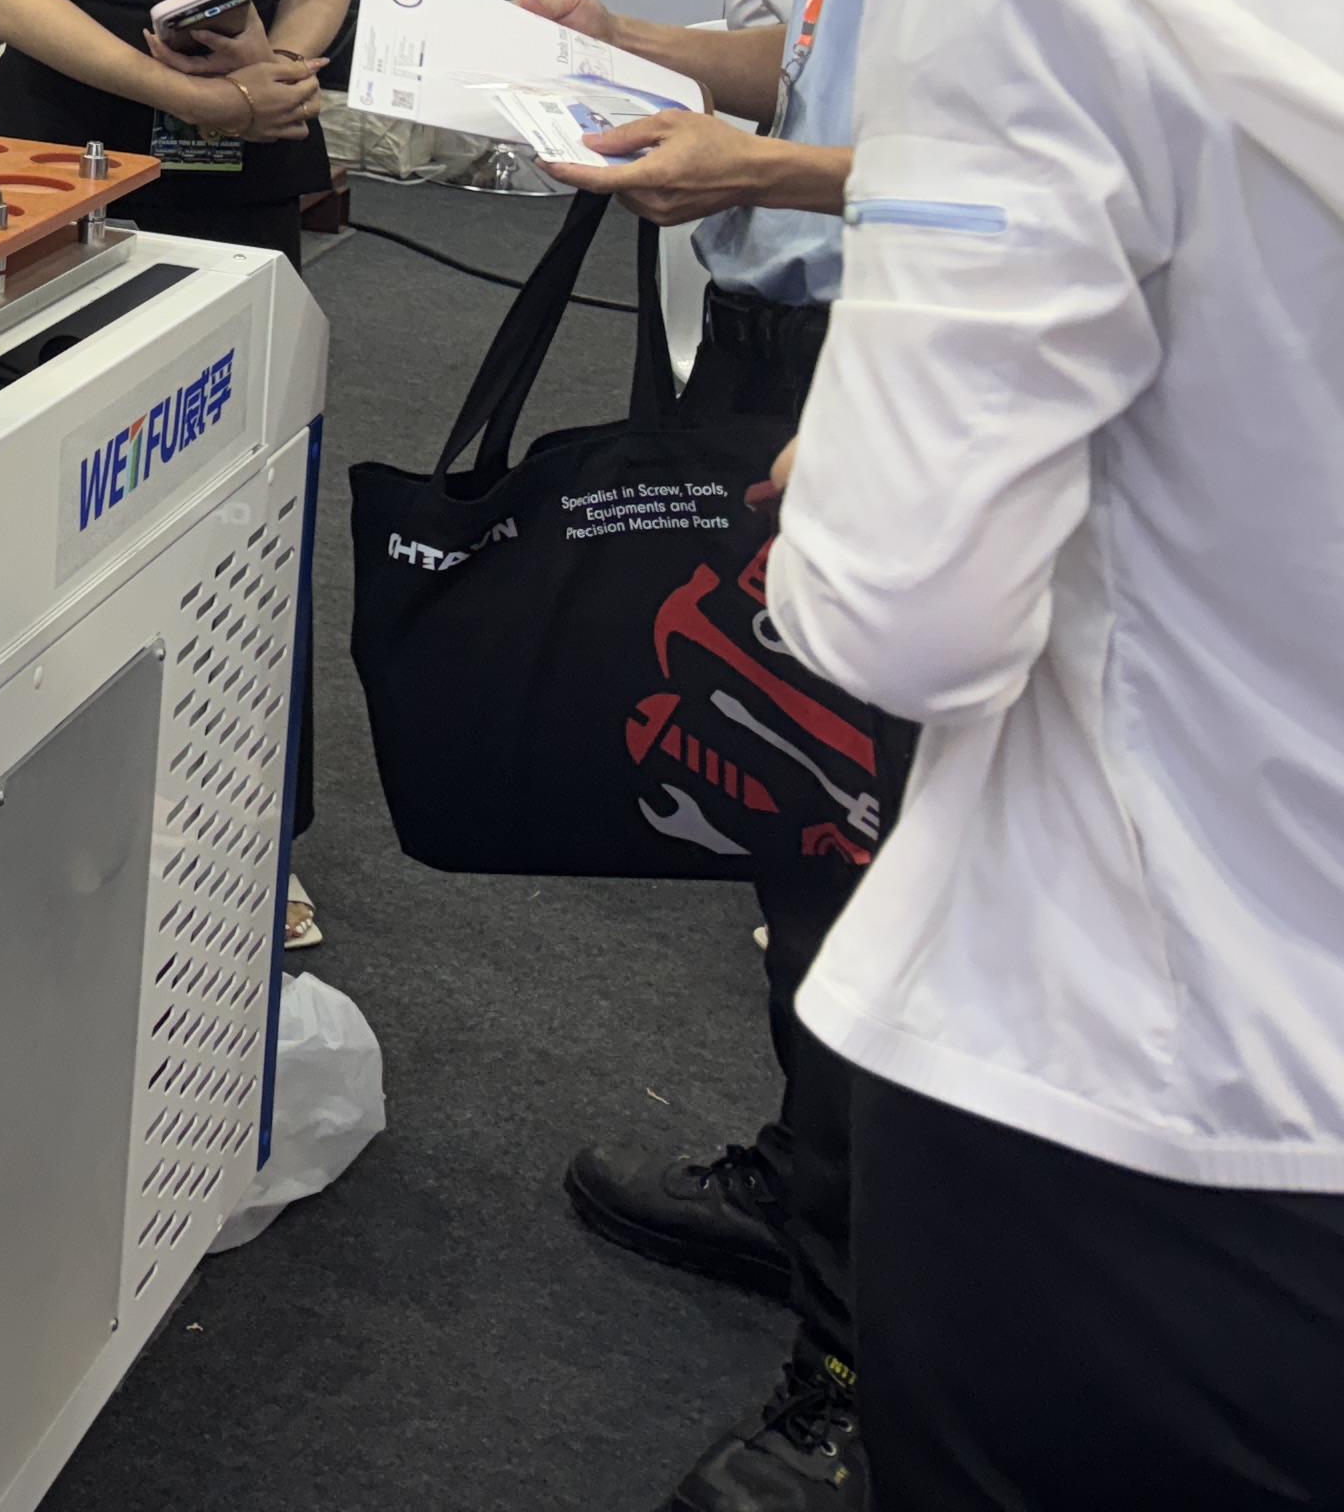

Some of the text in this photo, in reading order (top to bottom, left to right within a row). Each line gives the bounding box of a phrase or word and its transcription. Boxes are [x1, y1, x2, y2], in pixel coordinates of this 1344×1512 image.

[561, 482, 728, 511] Specialist in Screw, Tools,
[586, 500, 697, 521] Equipments and
[566, 515, 729, 539] Precision Machine Parts
